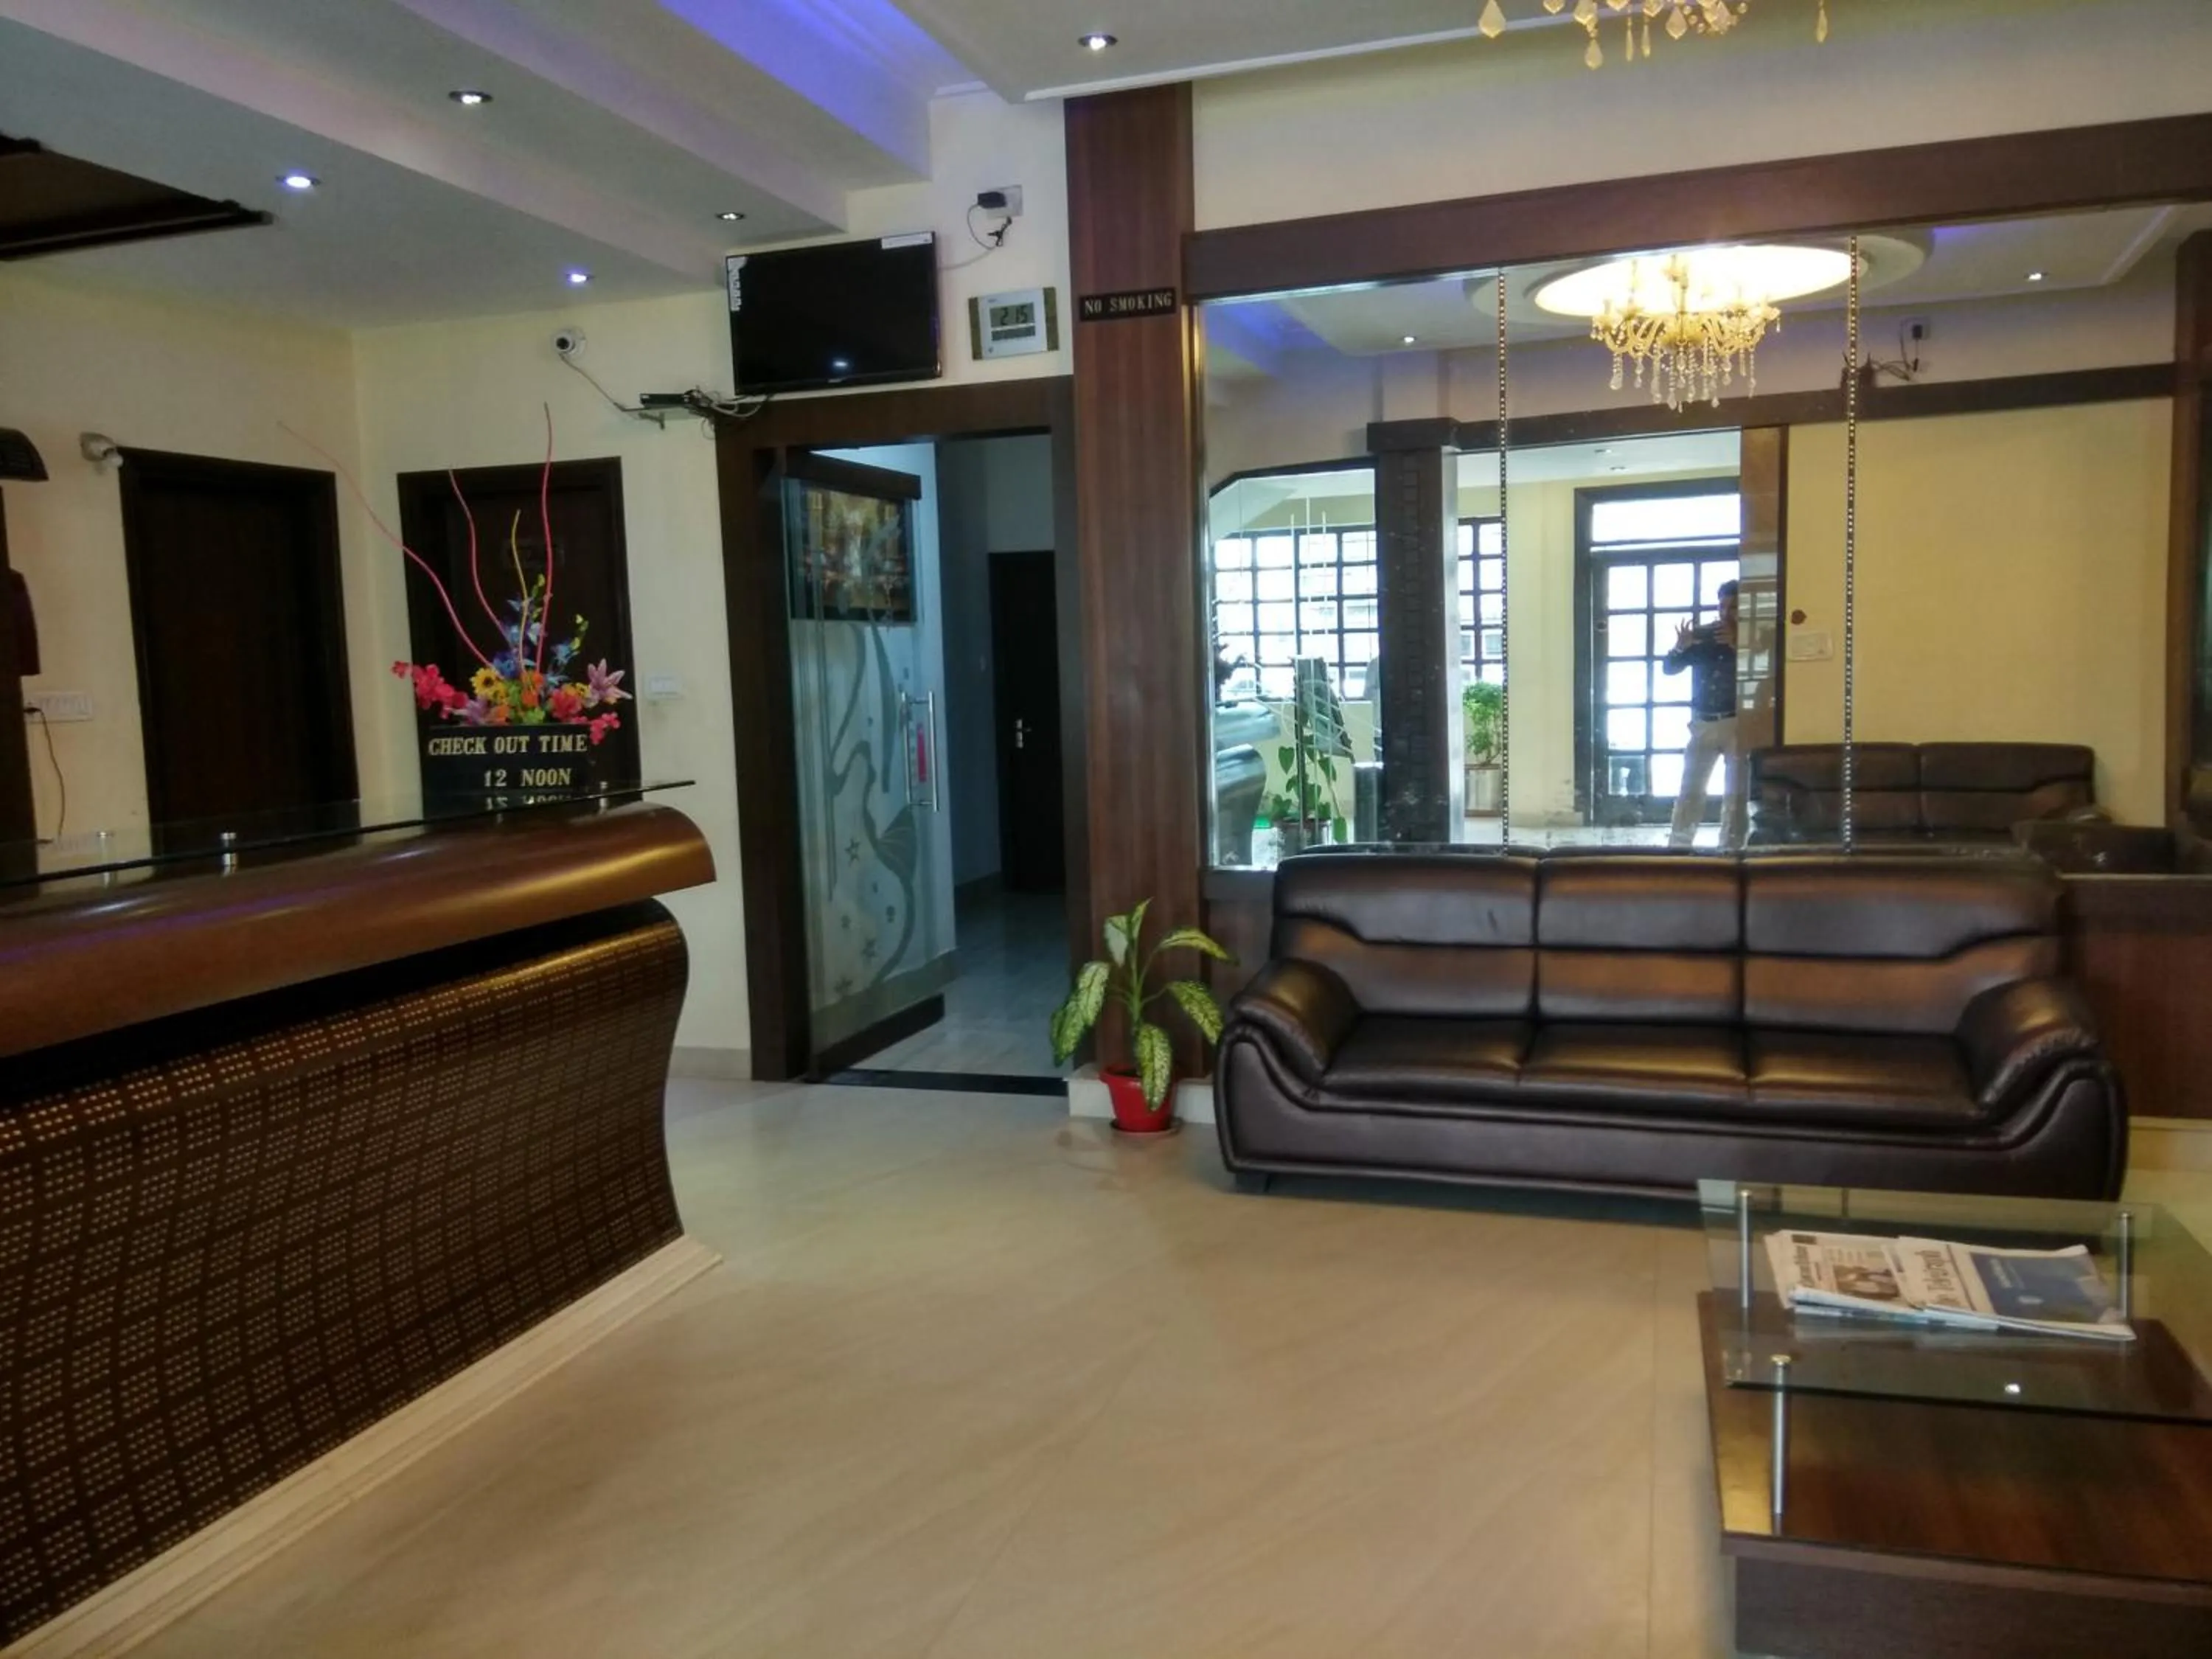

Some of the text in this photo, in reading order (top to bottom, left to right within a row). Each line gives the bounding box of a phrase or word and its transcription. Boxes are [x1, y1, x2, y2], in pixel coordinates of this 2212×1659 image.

[1085, 292, 1173, 314] NO SMOKING
[428, 734, 588, 756] CHECK OUT TIME
[484, 768, 572, 787] 12 NOON
